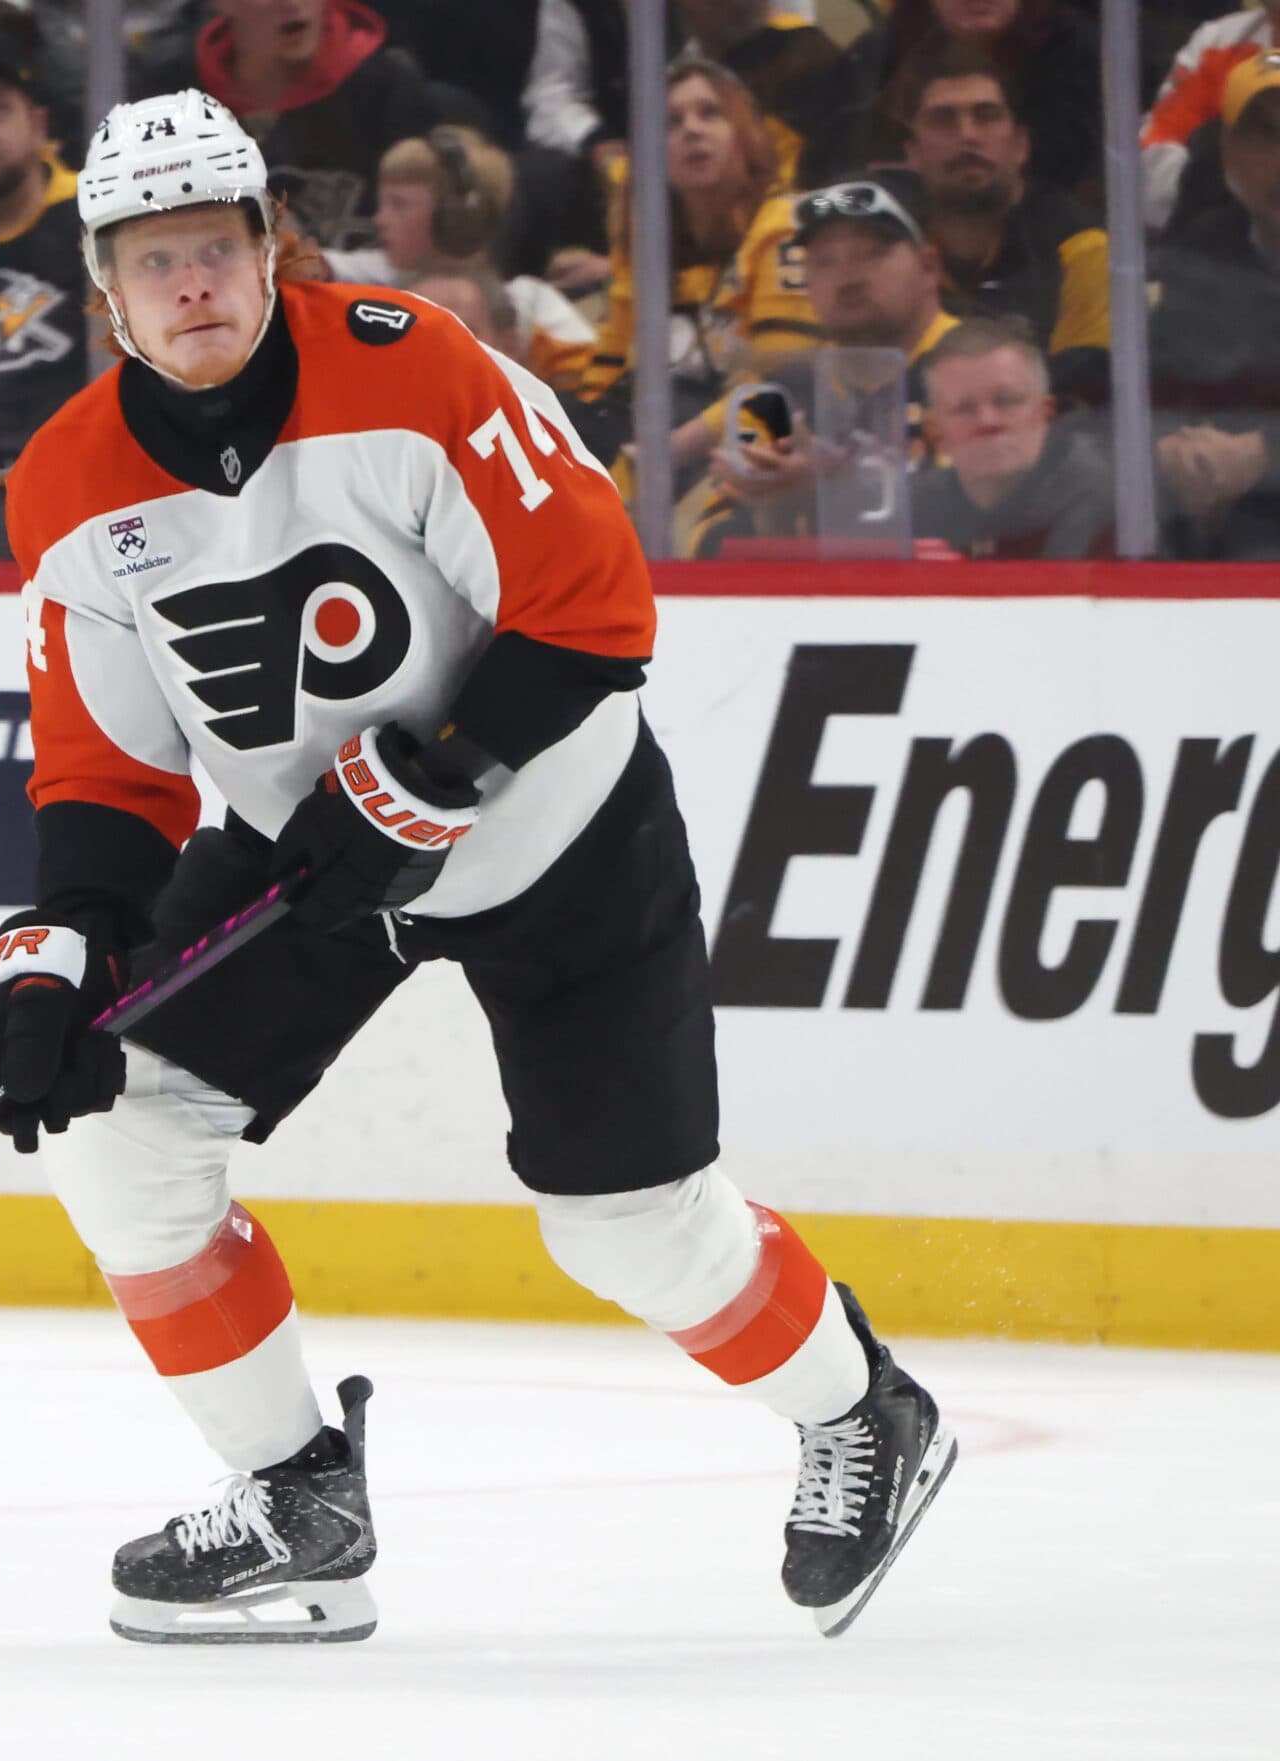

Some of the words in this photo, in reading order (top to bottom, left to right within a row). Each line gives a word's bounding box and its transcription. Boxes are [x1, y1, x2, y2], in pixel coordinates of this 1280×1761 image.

[136, 117, 177, 142] 74
[132, 159, 192, 181] BAUER
[126, 556, 172, 575] Medicine
